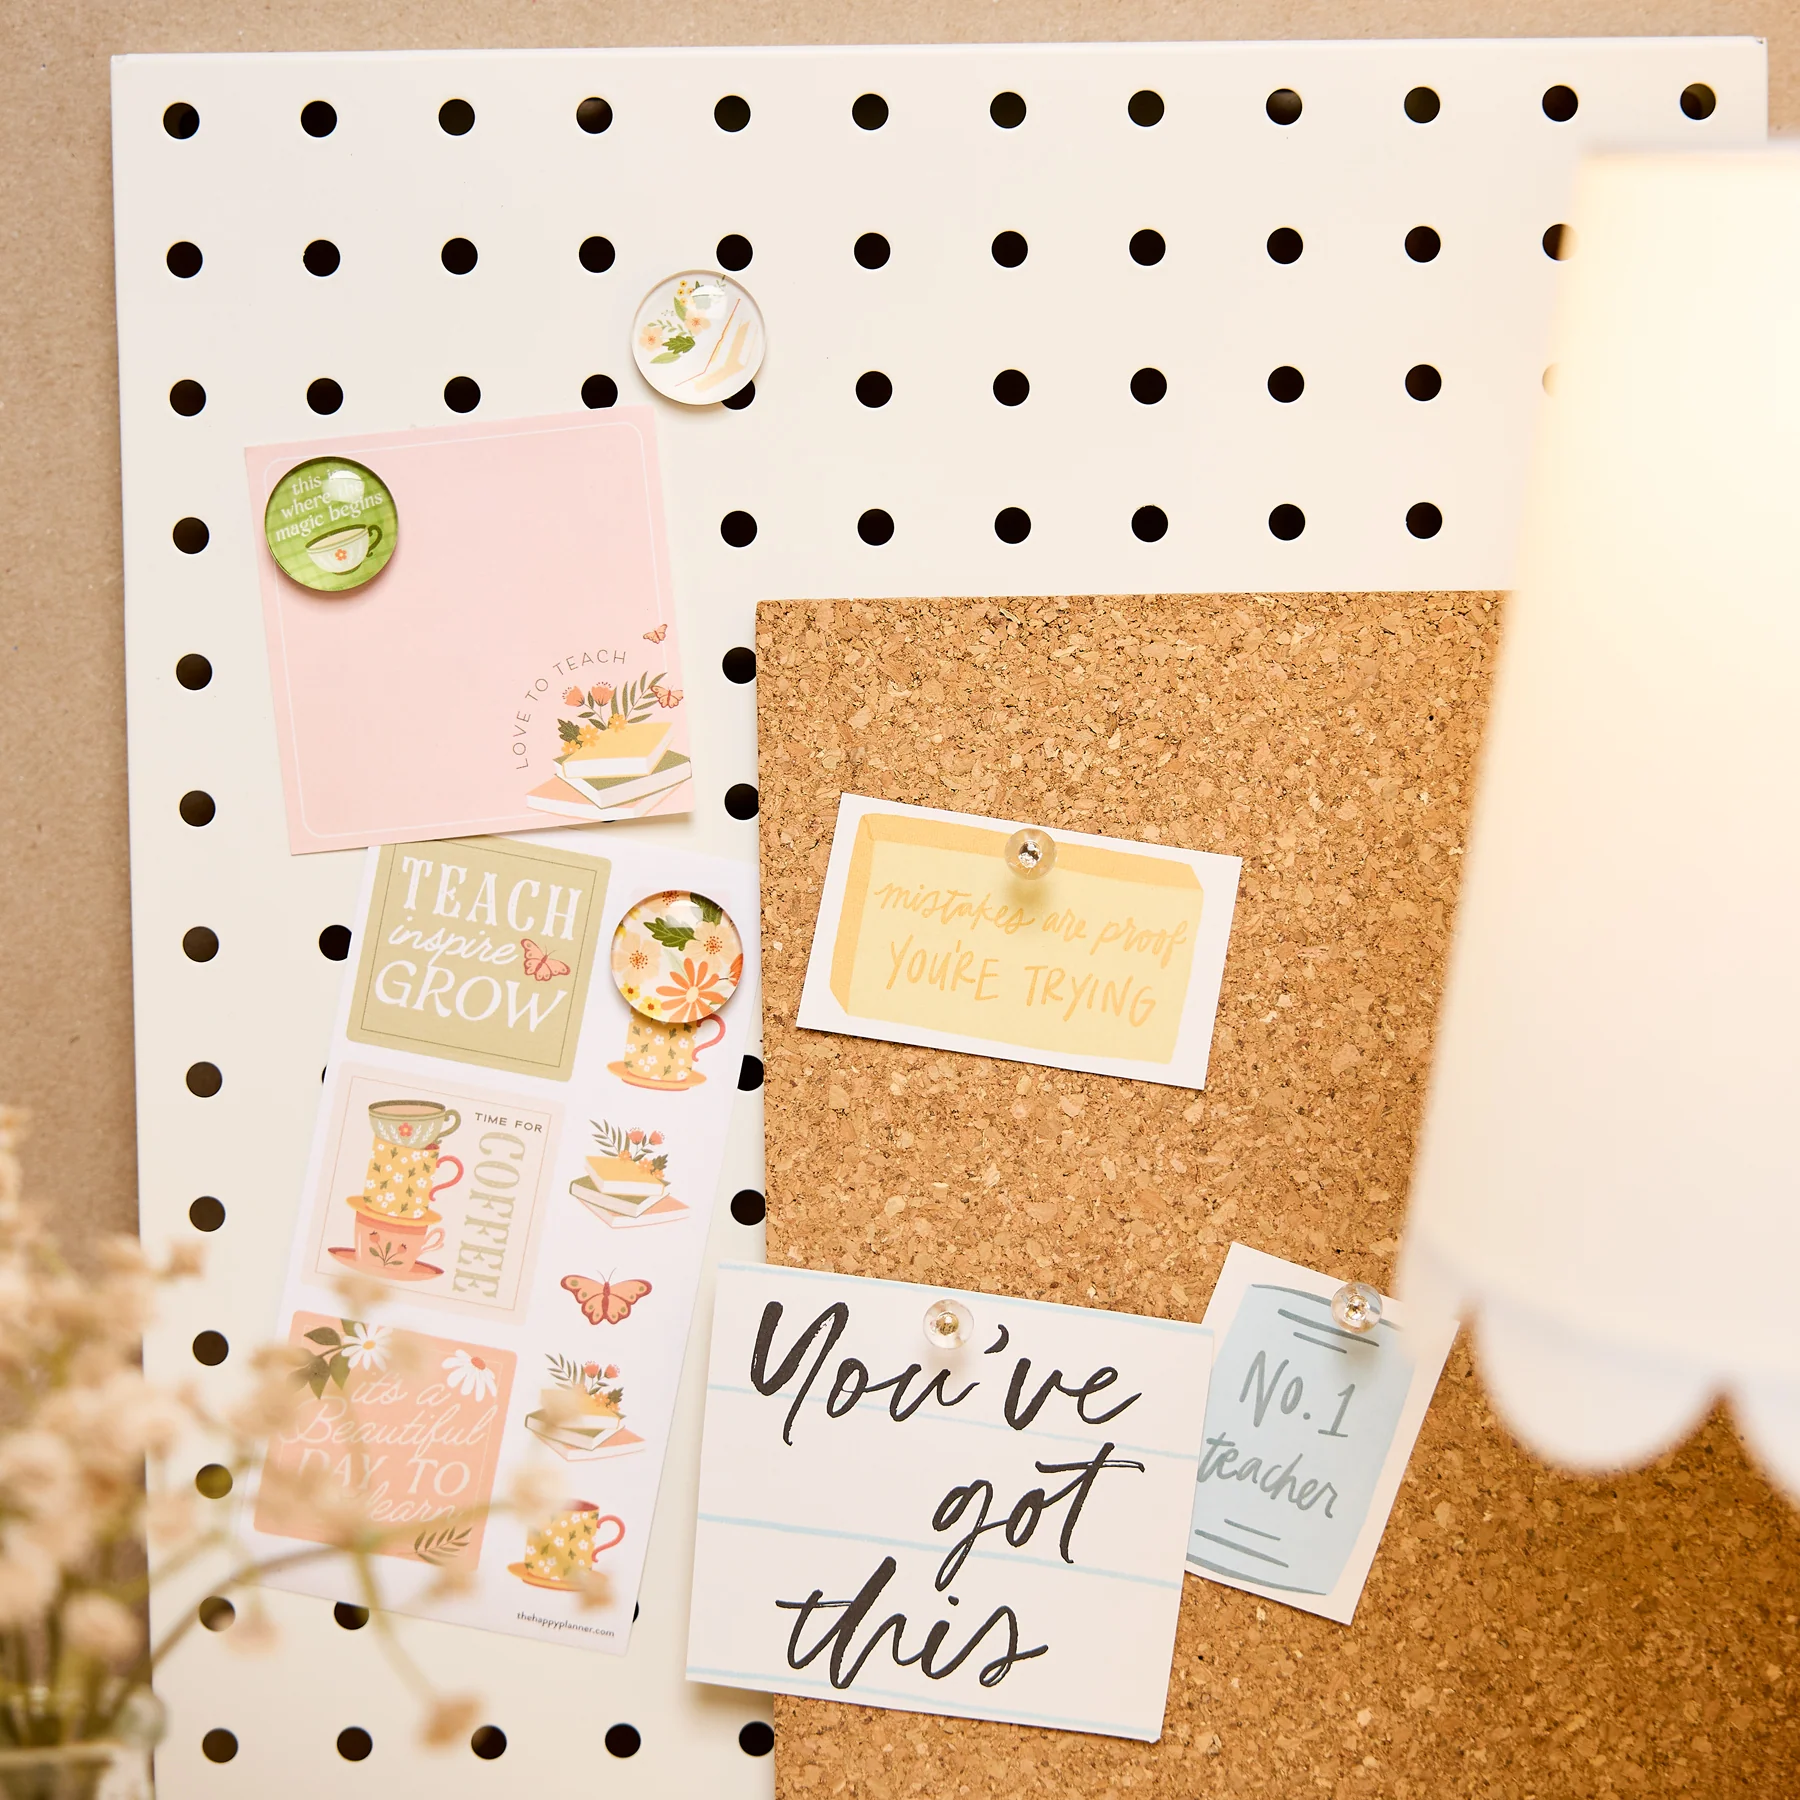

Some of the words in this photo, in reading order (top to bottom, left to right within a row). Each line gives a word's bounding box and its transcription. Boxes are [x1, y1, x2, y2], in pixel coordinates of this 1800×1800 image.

[275, 513, 325, 542] magic
[328, 492, 383, 522] begins
[280, 492, 331, 519] where
[292, 475, 321, 495] this
[512, 710, 532, 770] LOVE
[524, 678, 549, 701] TO
[552, 649, 626, 676] TEACH
[402, 856, 583, 941] TEACH
[873, 882, 1037, 936] mistakes
[1041, 907, 1088, 942] are
[1088, 919, 1190, 970] proof
[388, 916, 518, 966] inspire
[374, 960, 568, 1033] GROW
[886, 934, 1000, 1002] YOU'RE
[1024, 965, 1156, 1028] TRYING
[475, 1112, 508, 1126] TIME
[514, 1120, 543, 1133] FOR
[452, 1131, 526, 1298] COFFEE
[415, 1383, 452, 1405] a
[749, 1300, 1144, 1446] You've
[1239, 1350, 1311, 1428] No.
[1317, 1383, 1356, 1438] 1
[279, 1395, 499, 1458] Beautiful
[404, 1457, 471, 1497] TO
[1196, 1431, 1339, 1519] teacher
[931, 1441, 1146, 1592] got
[516, 1611, 616, 1638] thehappyplanner.com
[774, 1555, 1049, 1690] this
